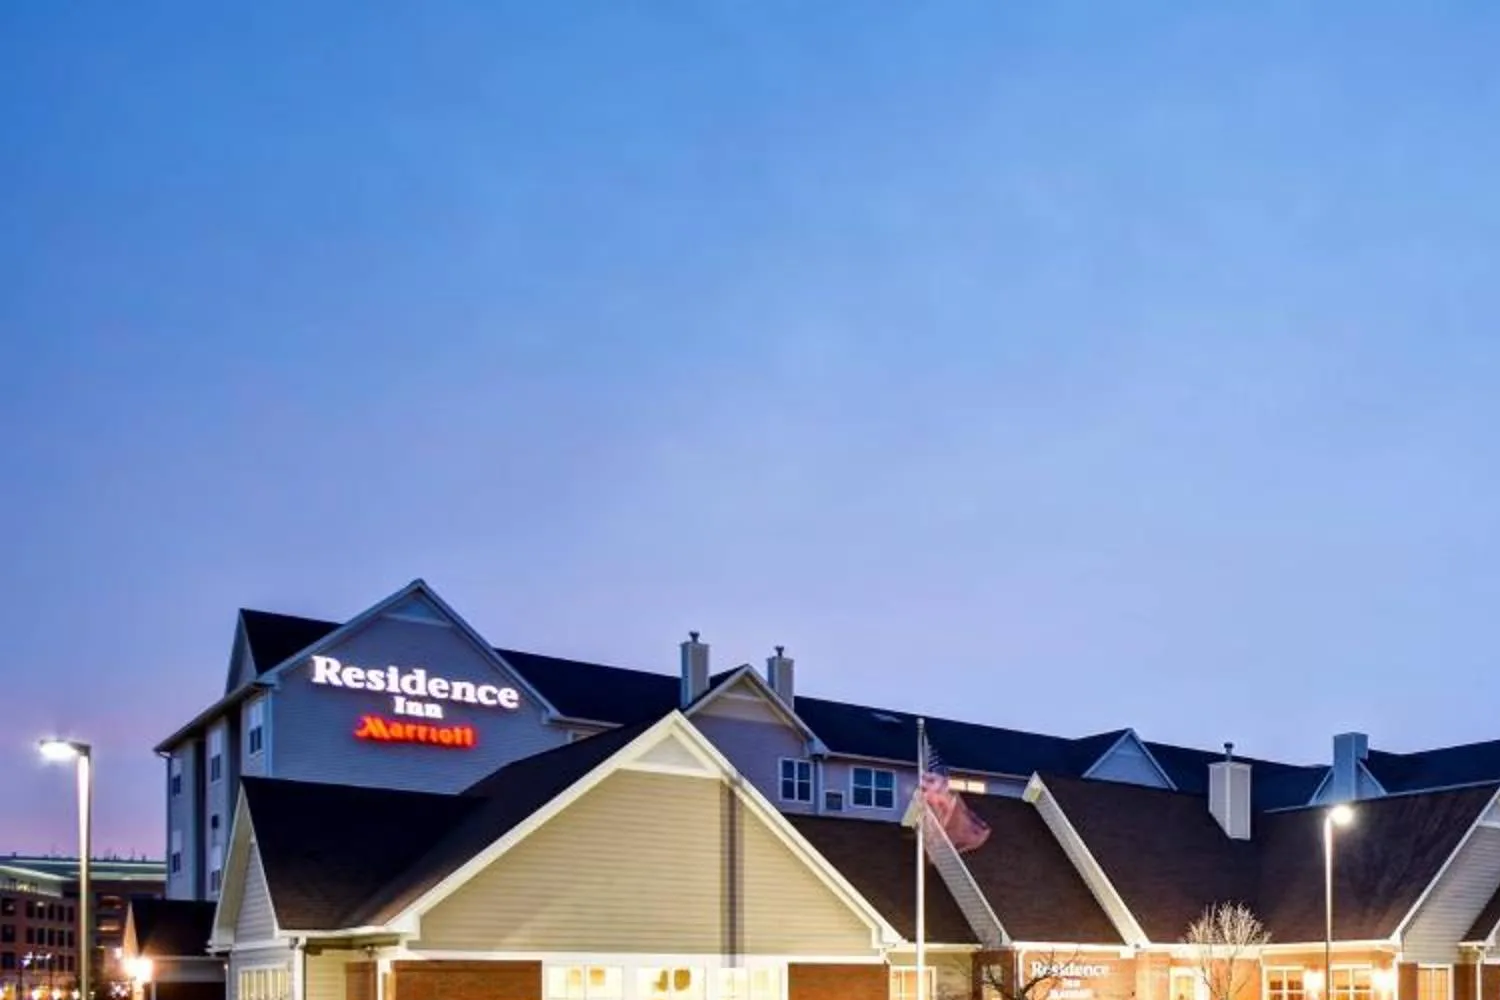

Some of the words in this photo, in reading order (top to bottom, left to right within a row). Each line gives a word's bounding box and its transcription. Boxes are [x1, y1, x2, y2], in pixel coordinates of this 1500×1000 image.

[311, 655, 519, 709] Residence
[393, 696, 443, 719] Inn
[354, 714, 476, 747] Marriott
